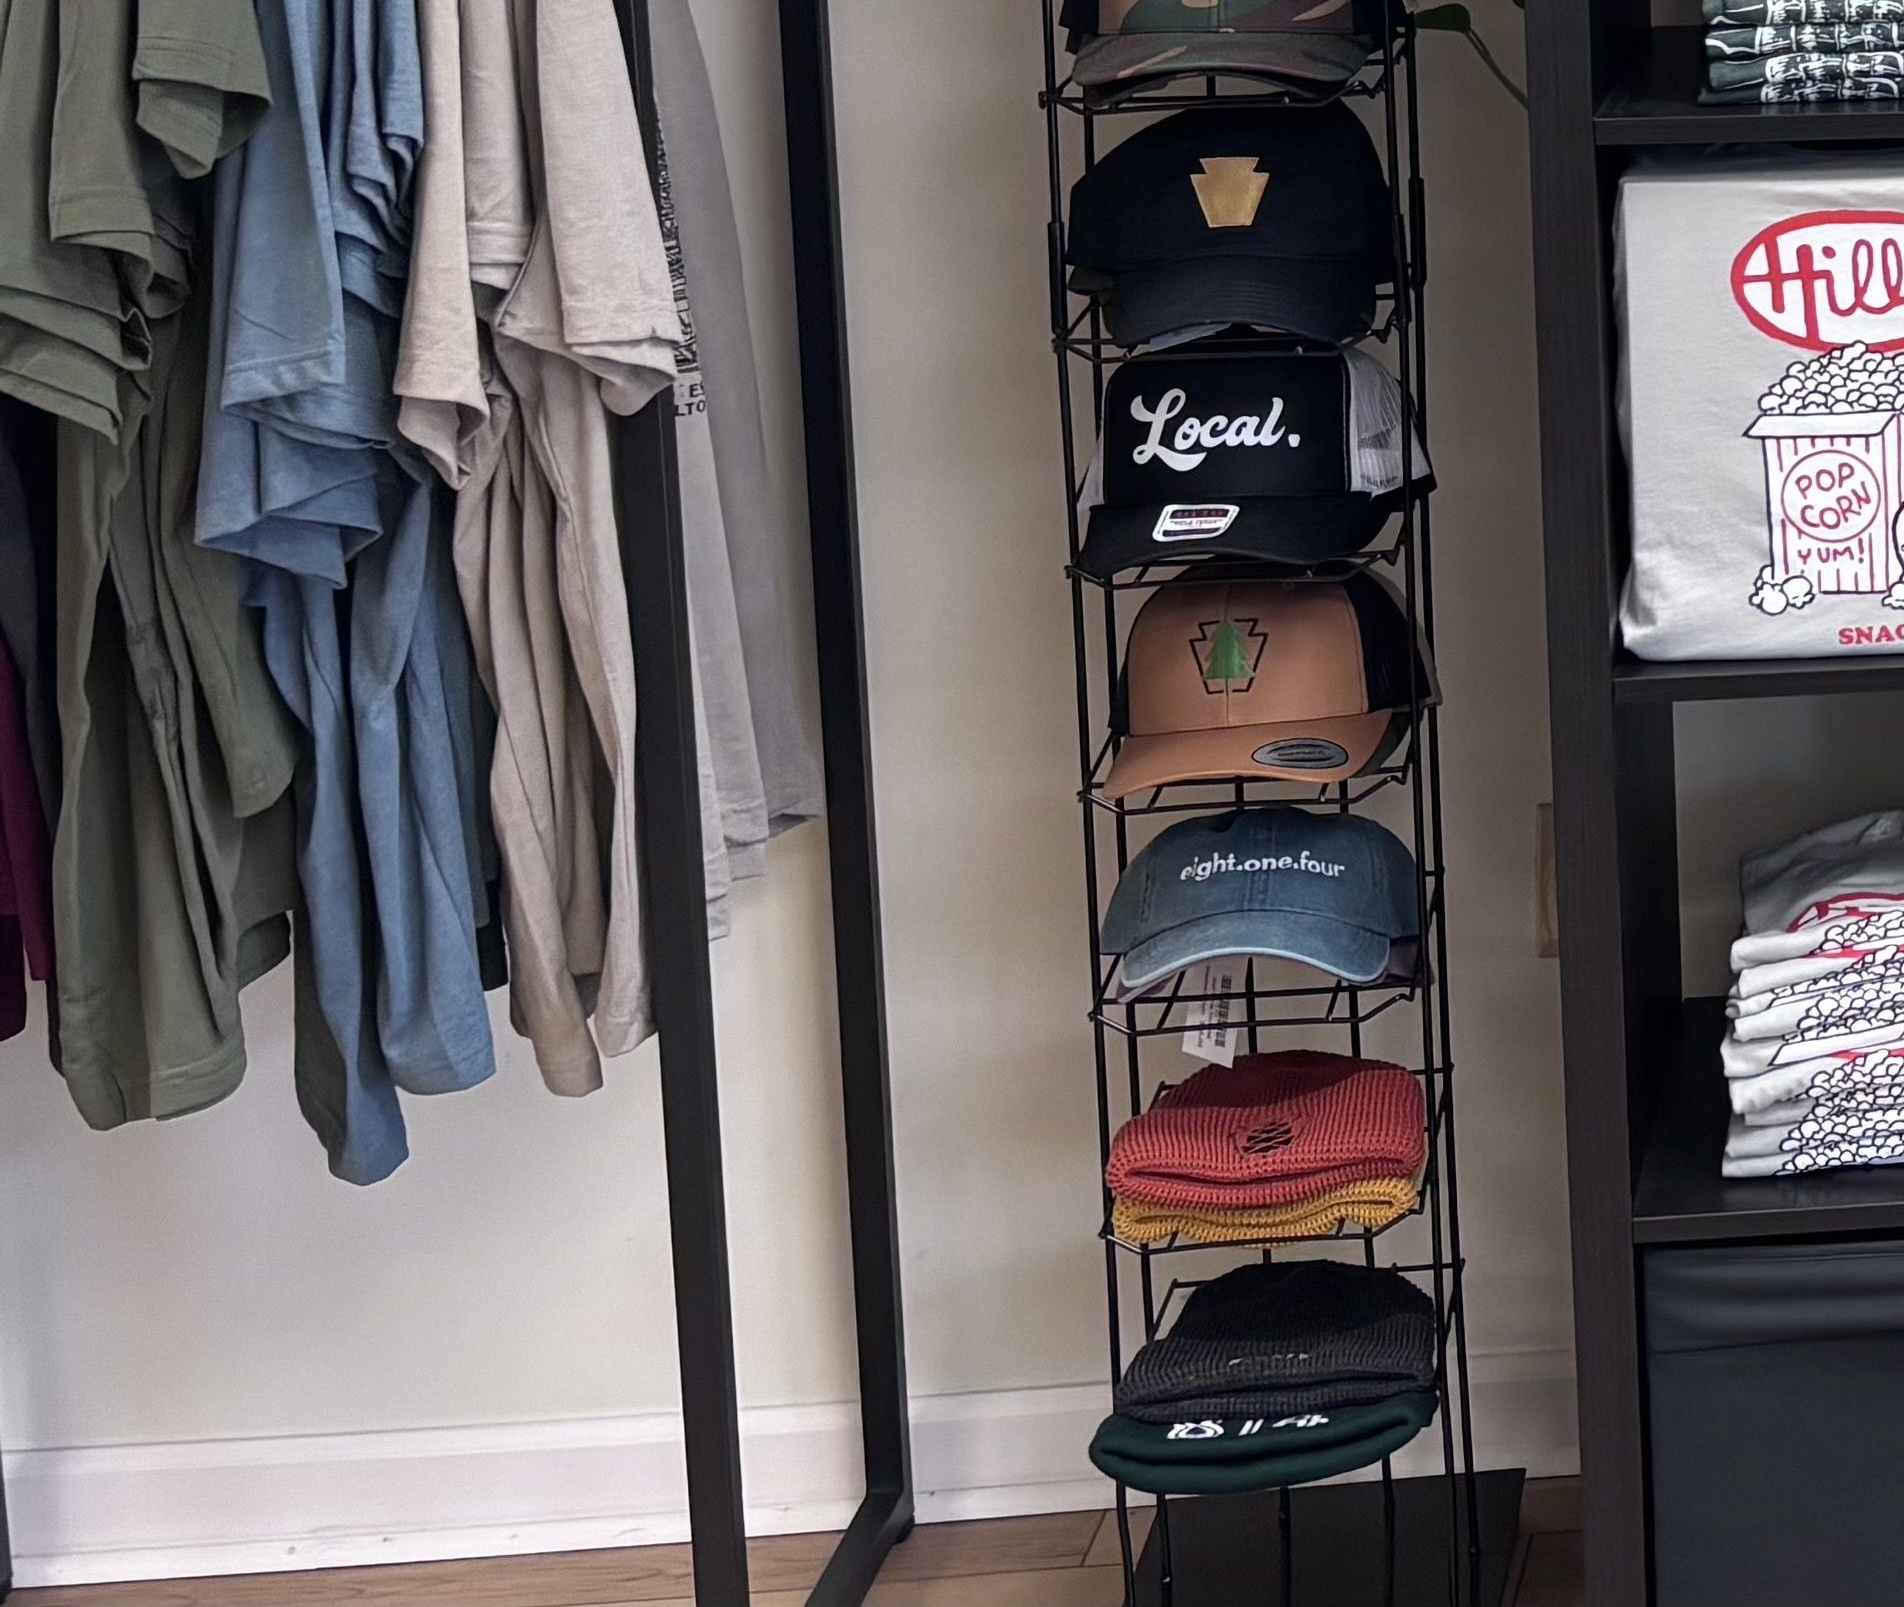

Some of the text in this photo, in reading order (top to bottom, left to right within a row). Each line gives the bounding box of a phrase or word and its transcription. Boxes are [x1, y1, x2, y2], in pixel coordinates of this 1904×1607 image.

[1130, 388, 1301, 473] Local.
[1796, 462, 1855, 501] POP
[1800, 481, 1872, 530] CORN
[1797, 537, 1866, 564] YUM!
[1179, 850, 1345, 882] eight.one.four
